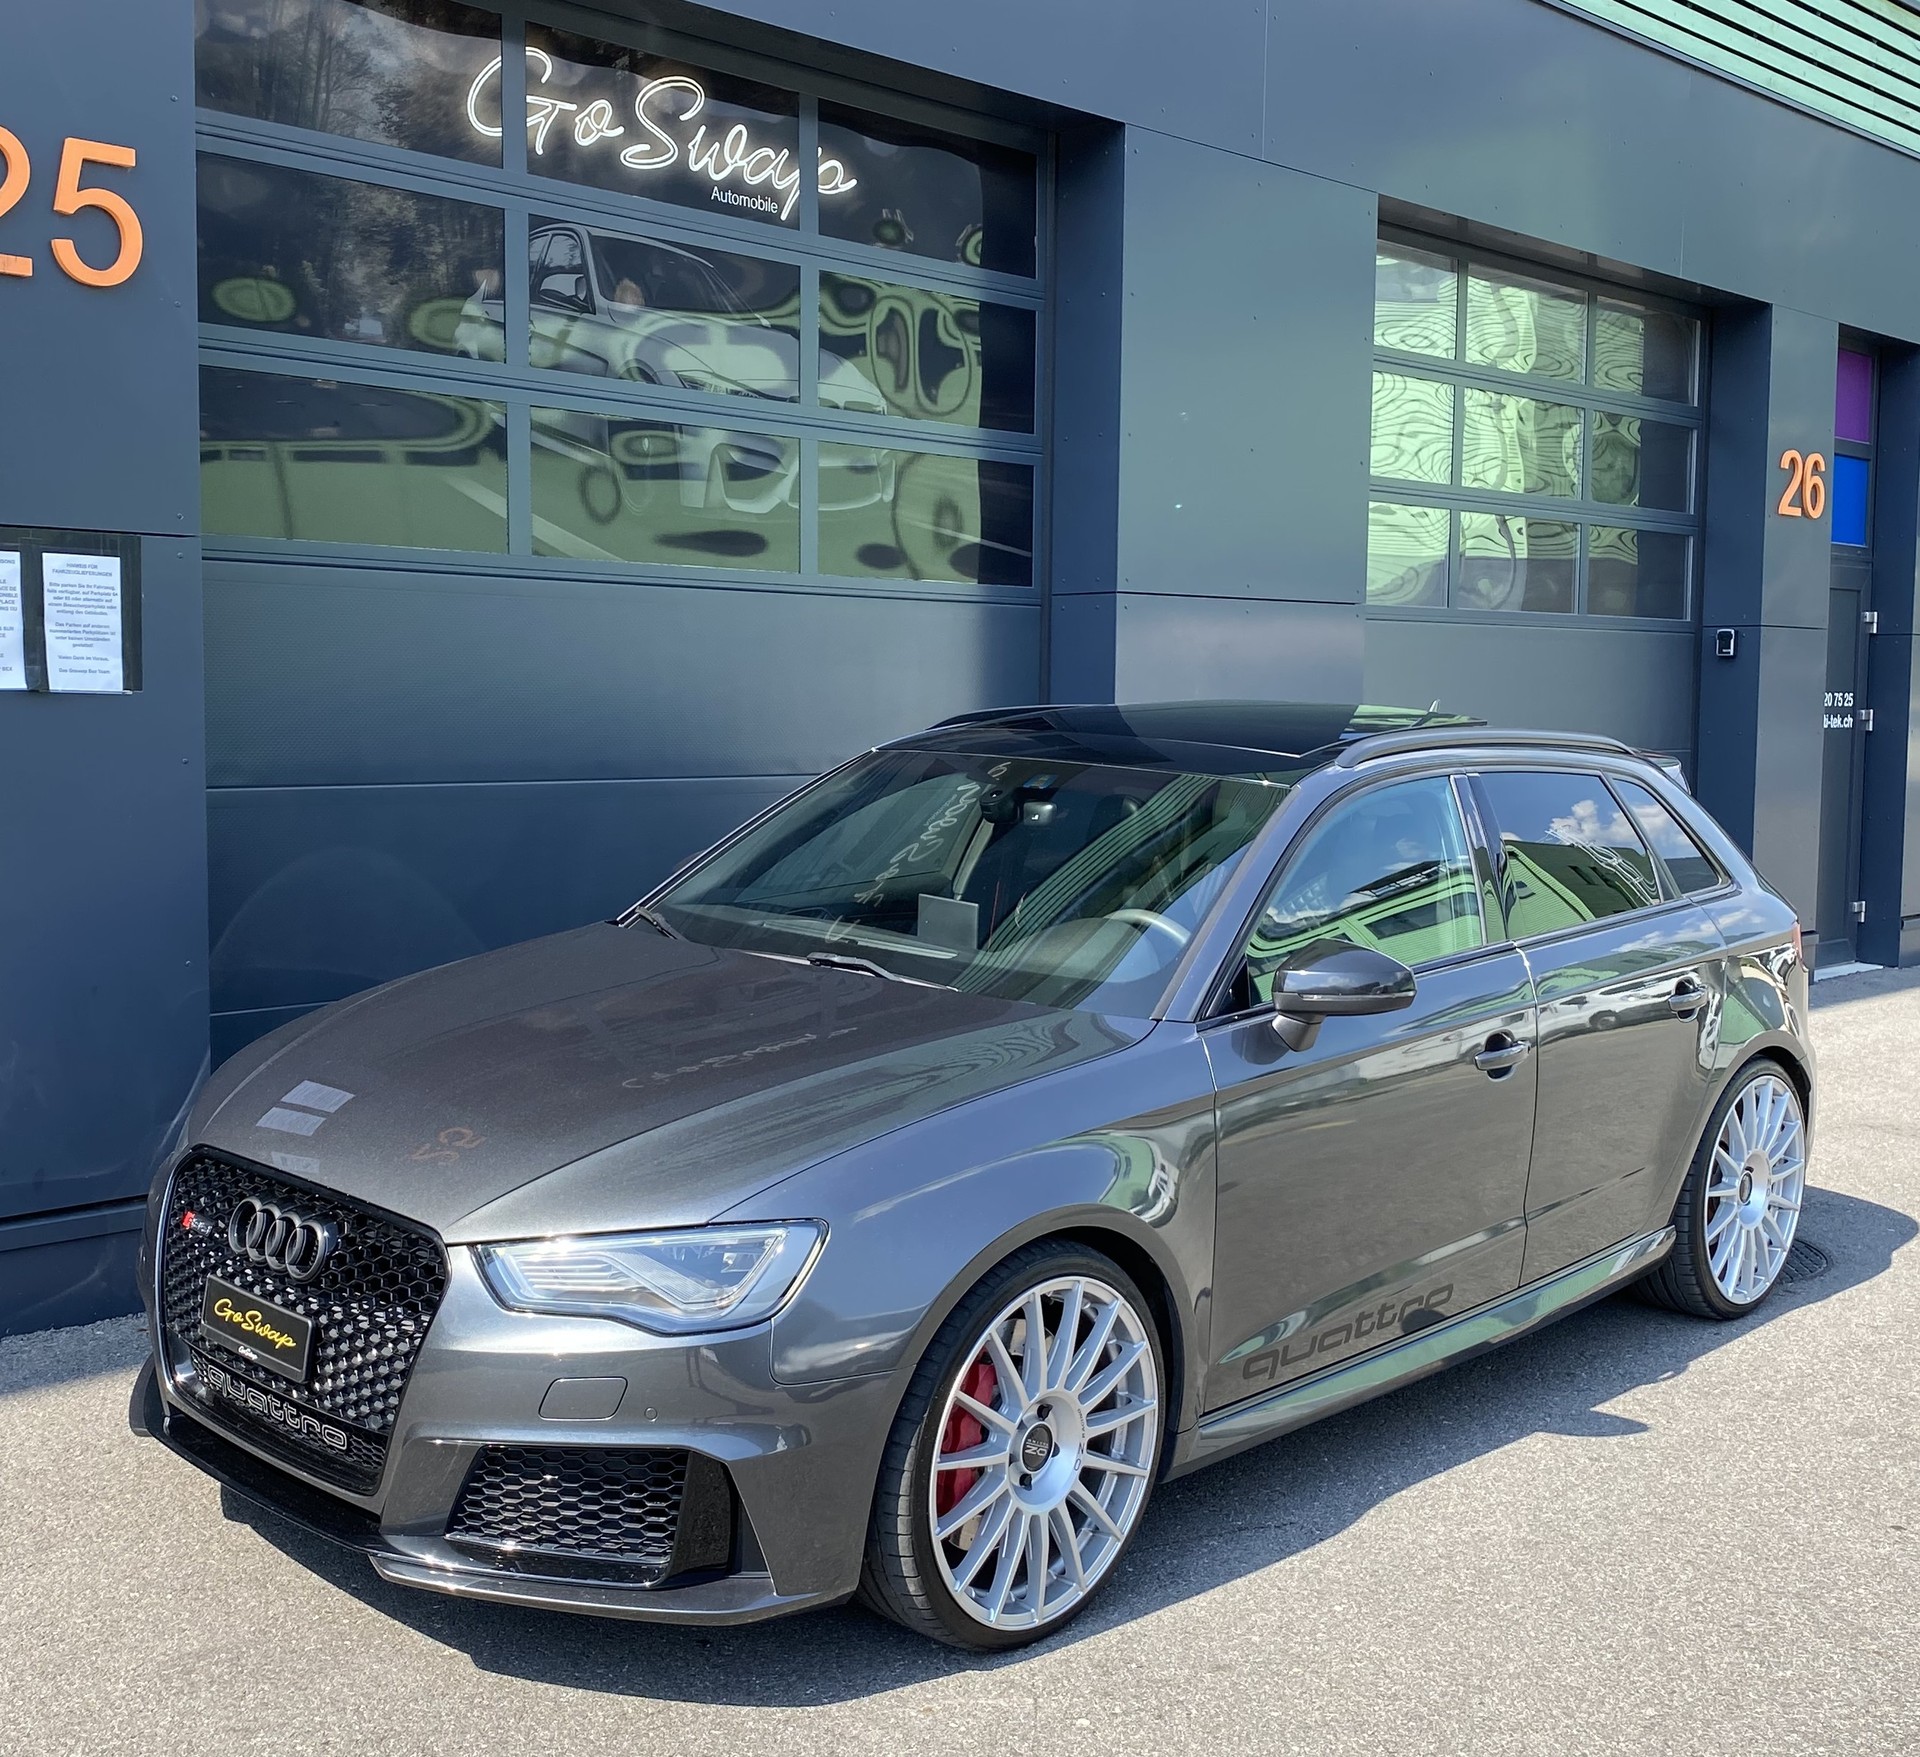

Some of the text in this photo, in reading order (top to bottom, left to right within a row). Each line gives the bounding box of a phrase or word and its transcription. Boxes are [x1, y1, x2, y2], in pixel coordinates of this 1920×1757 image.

[467, 46, 857, 221] GoSwap
[710, 185, 779, 215] Automobile
[1778, 449, 1826, 520] 26
[1834, 692, 1844, 707] 75
[1844, 692, 1854, 707] 25
[214, 1299, 297, 1349] GoSwap
[1242, 1283, 1454, 1381] quattro
[208, 1365, 348, 1450] quattro
